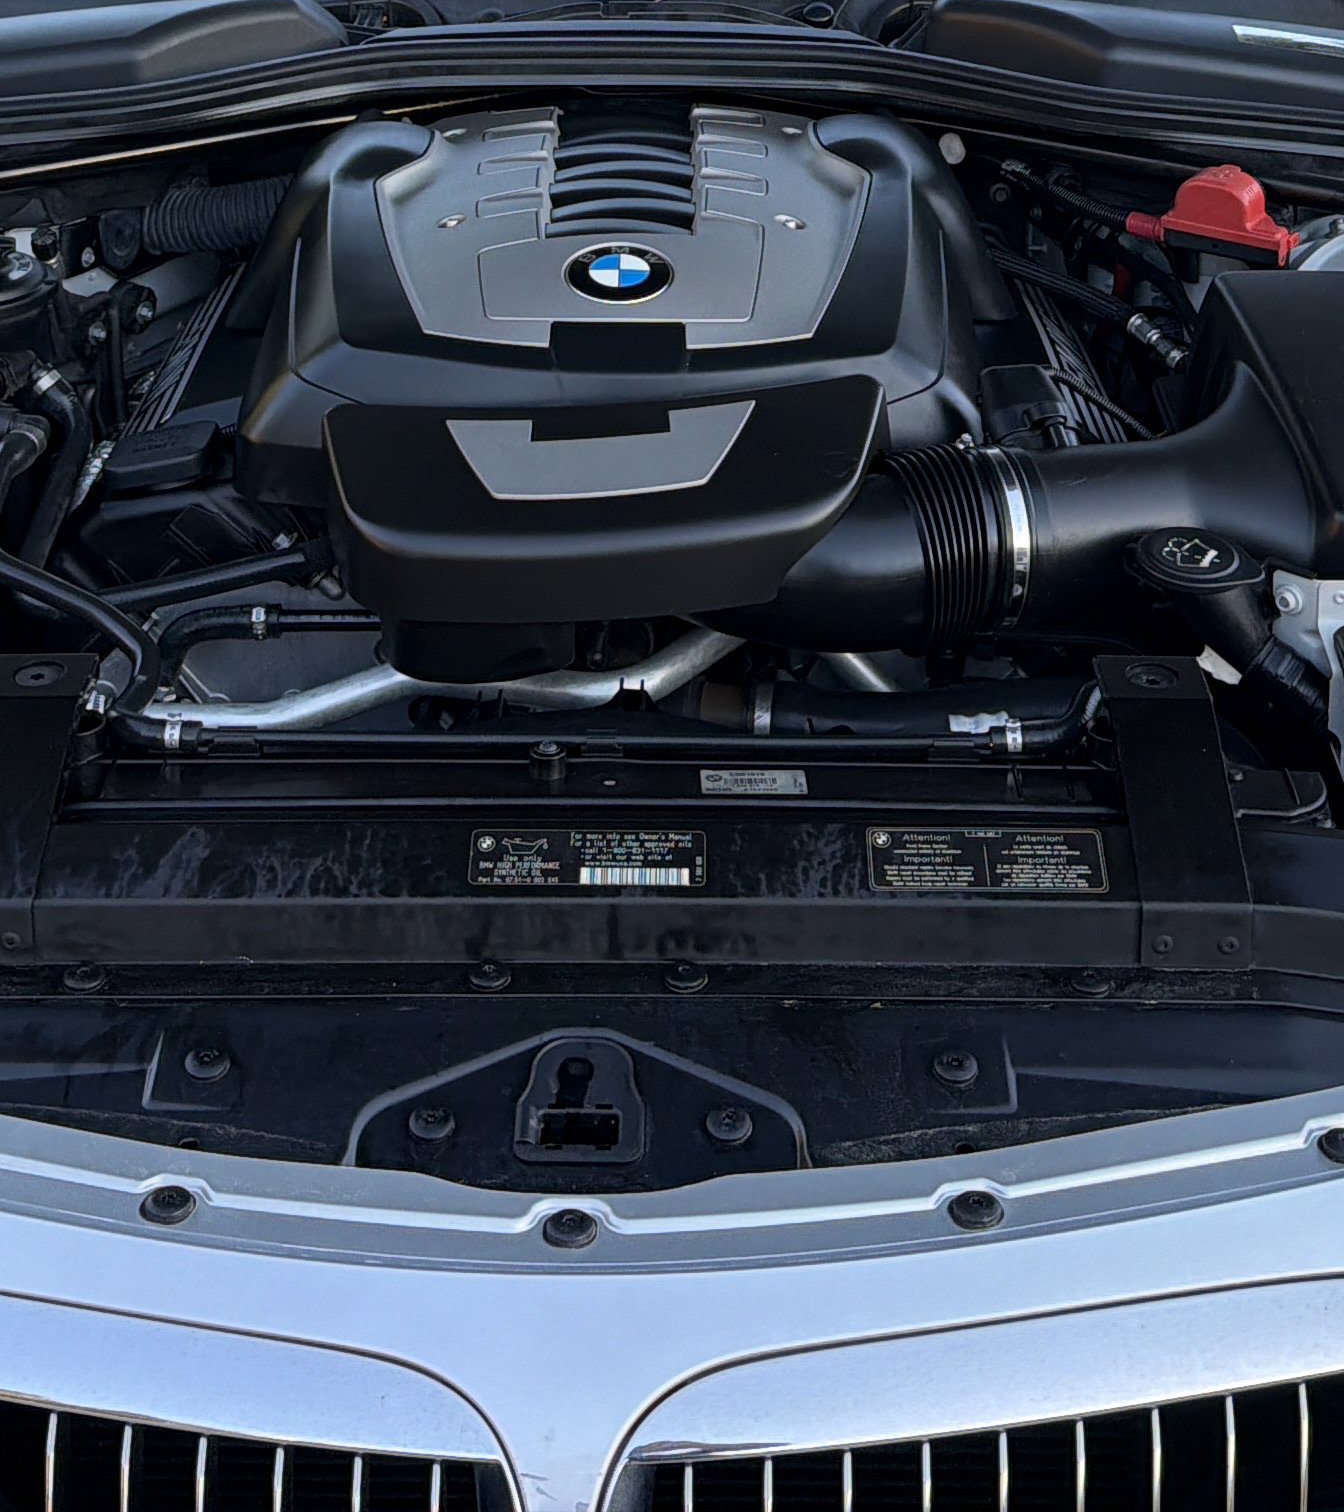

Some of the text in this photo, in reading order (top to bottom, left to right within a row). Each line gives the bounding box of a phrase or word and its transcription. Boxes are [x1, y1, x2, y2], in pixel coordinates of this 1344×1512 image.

[577, 245, 666, 264] BMW
[668, 832, 692, 841] Manual
[902, 835, 951, 843] Attention!
[1015, 834, 1064, 843] Attention!
[522, 854, 543, 863] only
[904, 855, 953, 864] Important!
[1017, 856, 1067, 865] Important!
